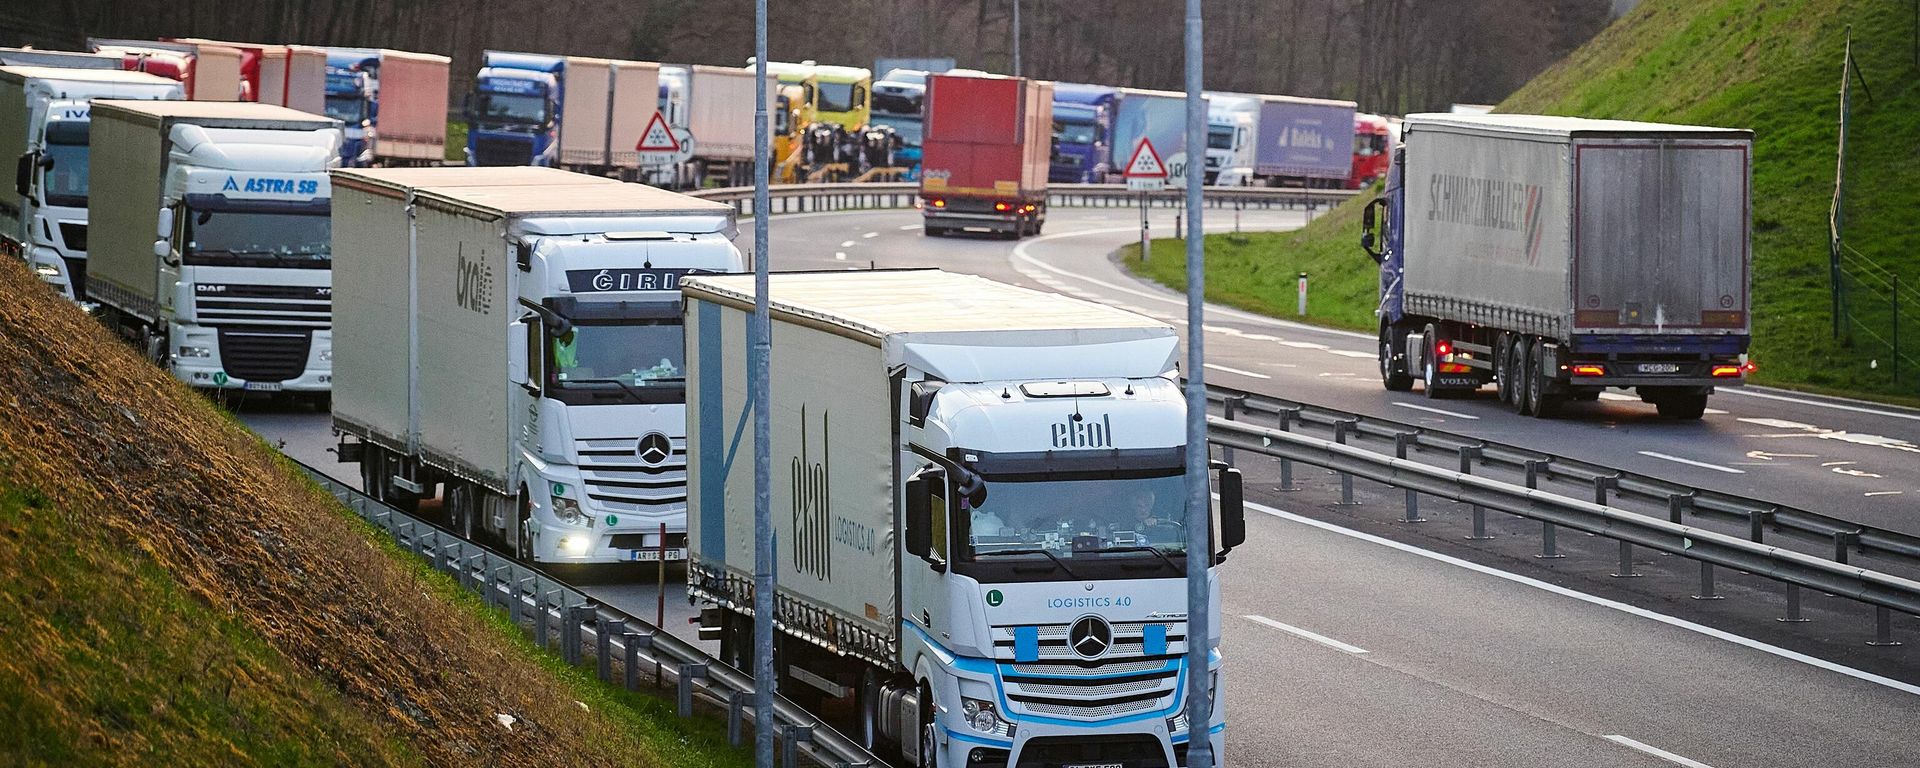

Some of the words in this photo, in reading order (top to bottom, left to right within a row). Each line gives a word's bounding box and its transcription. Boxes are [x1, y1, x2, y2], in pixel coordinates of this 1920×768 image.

[244, 178, 294, 193] ASTRA
[298, 180, 318, 194] SB
[1428, 174, 1527, 234] SCHWARZMÜLLER
[593, 269, 696, 291] ĆIRI
[1051, 413, 1111, 448] ekol
[792, 402, 831, 584] ekol
[834, 514, 865, 551] LOGISTICS
[990, 592, 999, 604] L
[1047, 597, 1110, 609] LOGISTICS
[1115, 596, 1132, 607] 4.0
